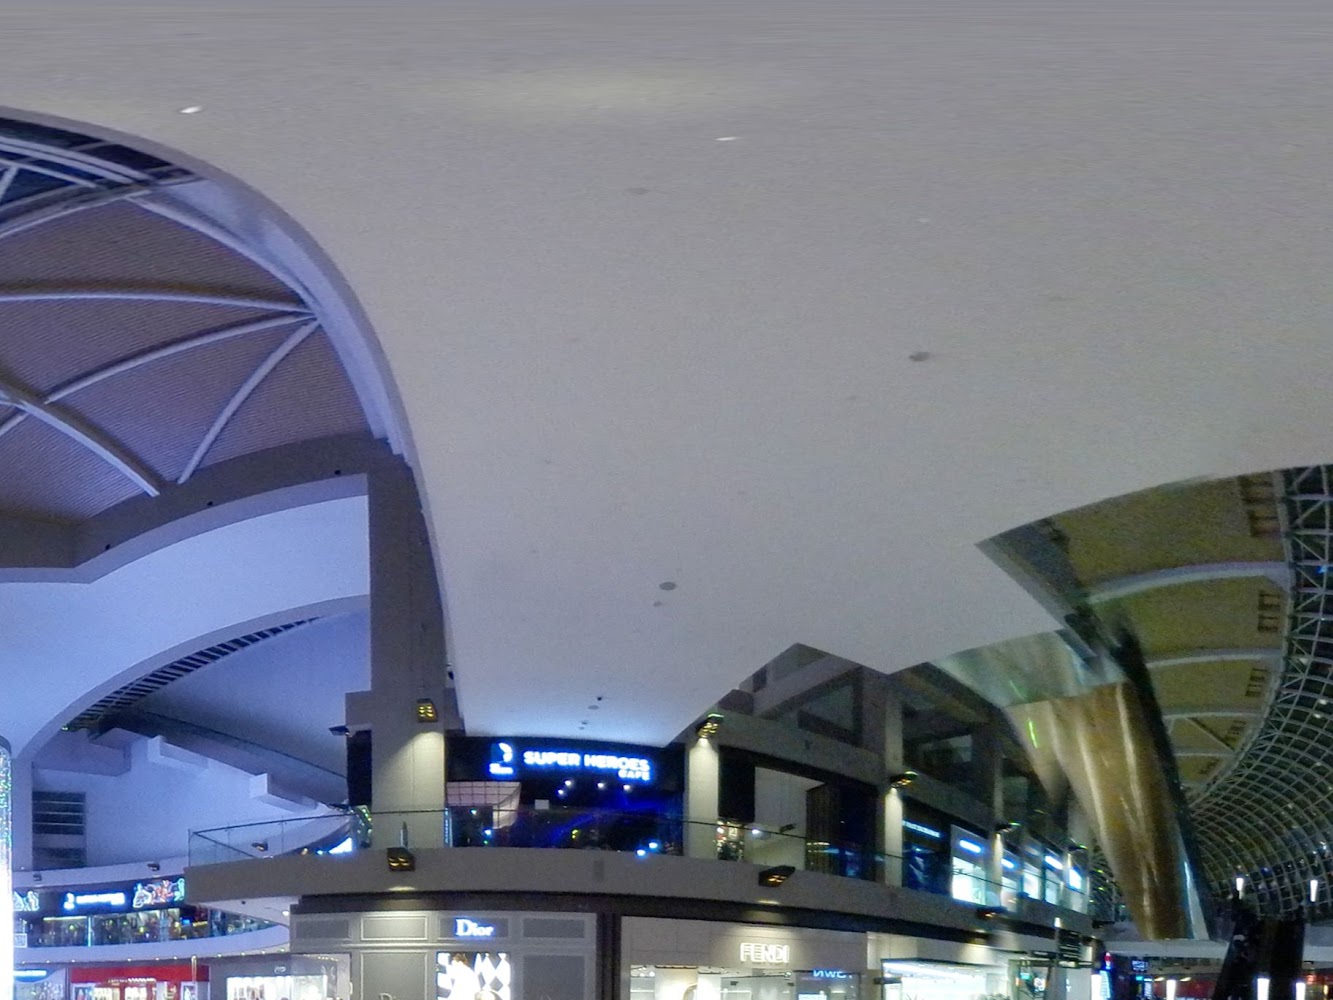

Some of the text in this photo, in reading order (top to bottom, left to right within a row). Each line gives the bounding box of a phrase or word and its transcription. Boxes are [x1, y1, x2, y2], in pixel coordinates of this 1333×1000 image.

[523, 751, 650, 771] SUPER HEROES
[455, 917, 495, 937] Dior
[740, 942, 790, 964] FENDI
